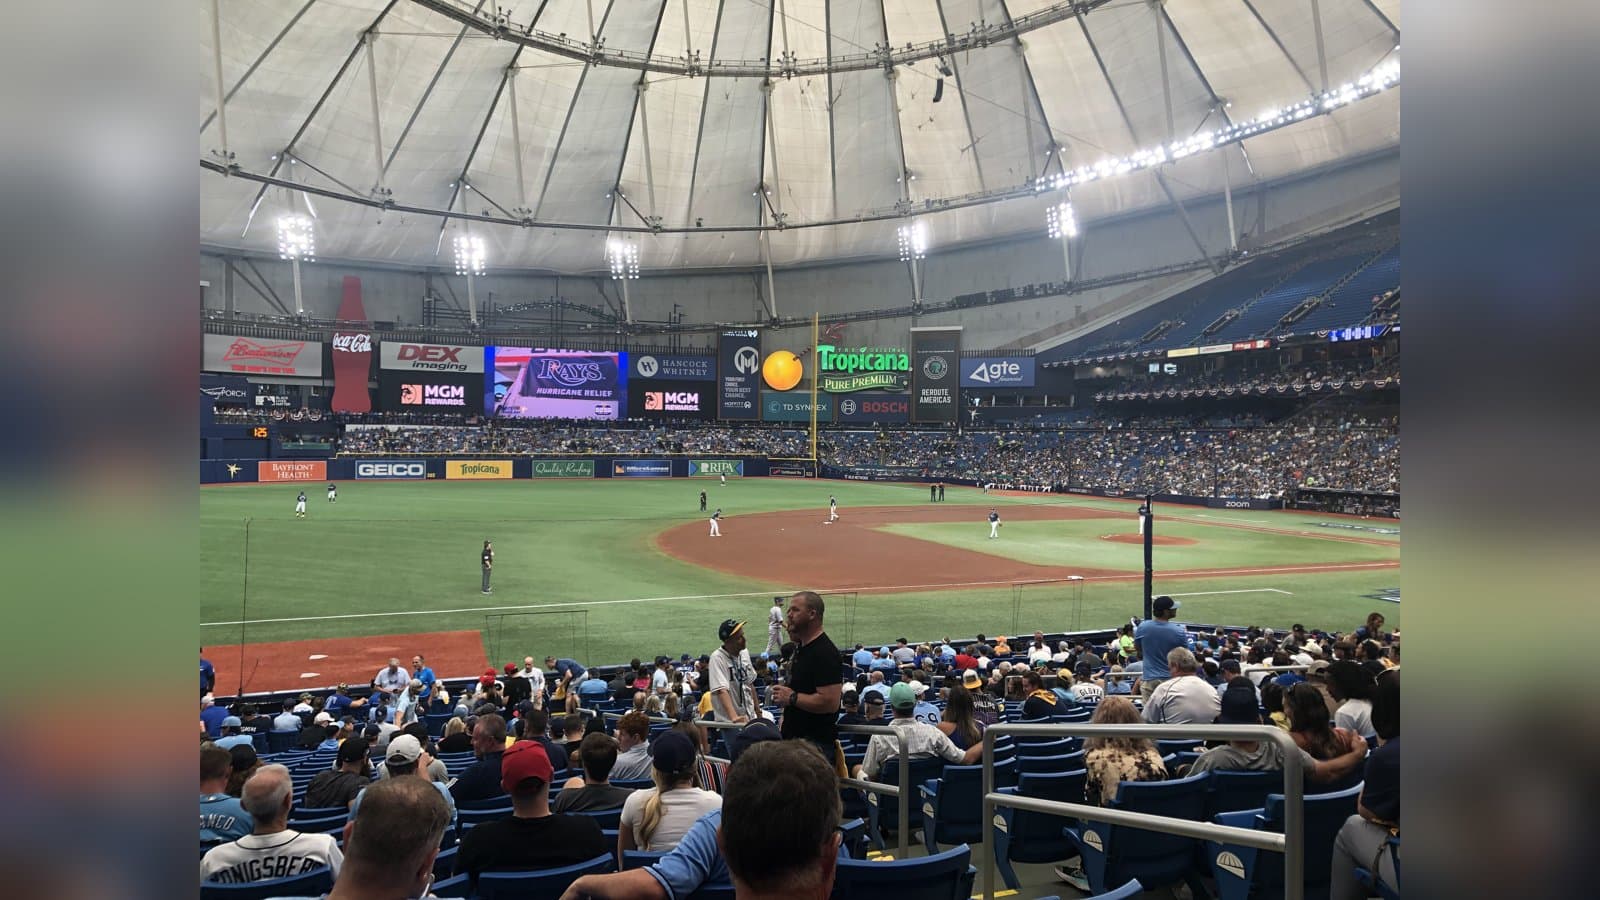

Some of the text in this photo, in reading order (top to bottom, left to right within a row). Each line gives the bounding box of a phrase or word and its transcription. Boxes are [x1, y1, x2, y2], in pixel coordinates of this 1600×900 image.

[333, 333, 372, 352] Coca-Cola
[397, 345, 462, 363] DEX
[817, 345, 909, 373] Tropicana
[412, 361, 468, 371] imaging
[663, 360, 708, 368] HANCOCK
[663, 368, 708, 376] WHITNEY
[990, 361, 1020, 379] gte
[825, 375, 897, 389] PURE PREMIUM
[425, 385, 464, 398] MGM
[536, 388, 583, 396] HURRICANE
[665, 393, 699, 404] MGM
[863, 402, 908, 413] BOSCH
[272, 463, 314, 471] BAYFRONT
[358, 464, 424, 476] GEICO
[460, 463, 500, 475] Tropicana
[535, 462, 592, 476] Quality Roofing
[710, 463, 734, 473] RIPA
[277, 471, 310, 479] HEALTH
